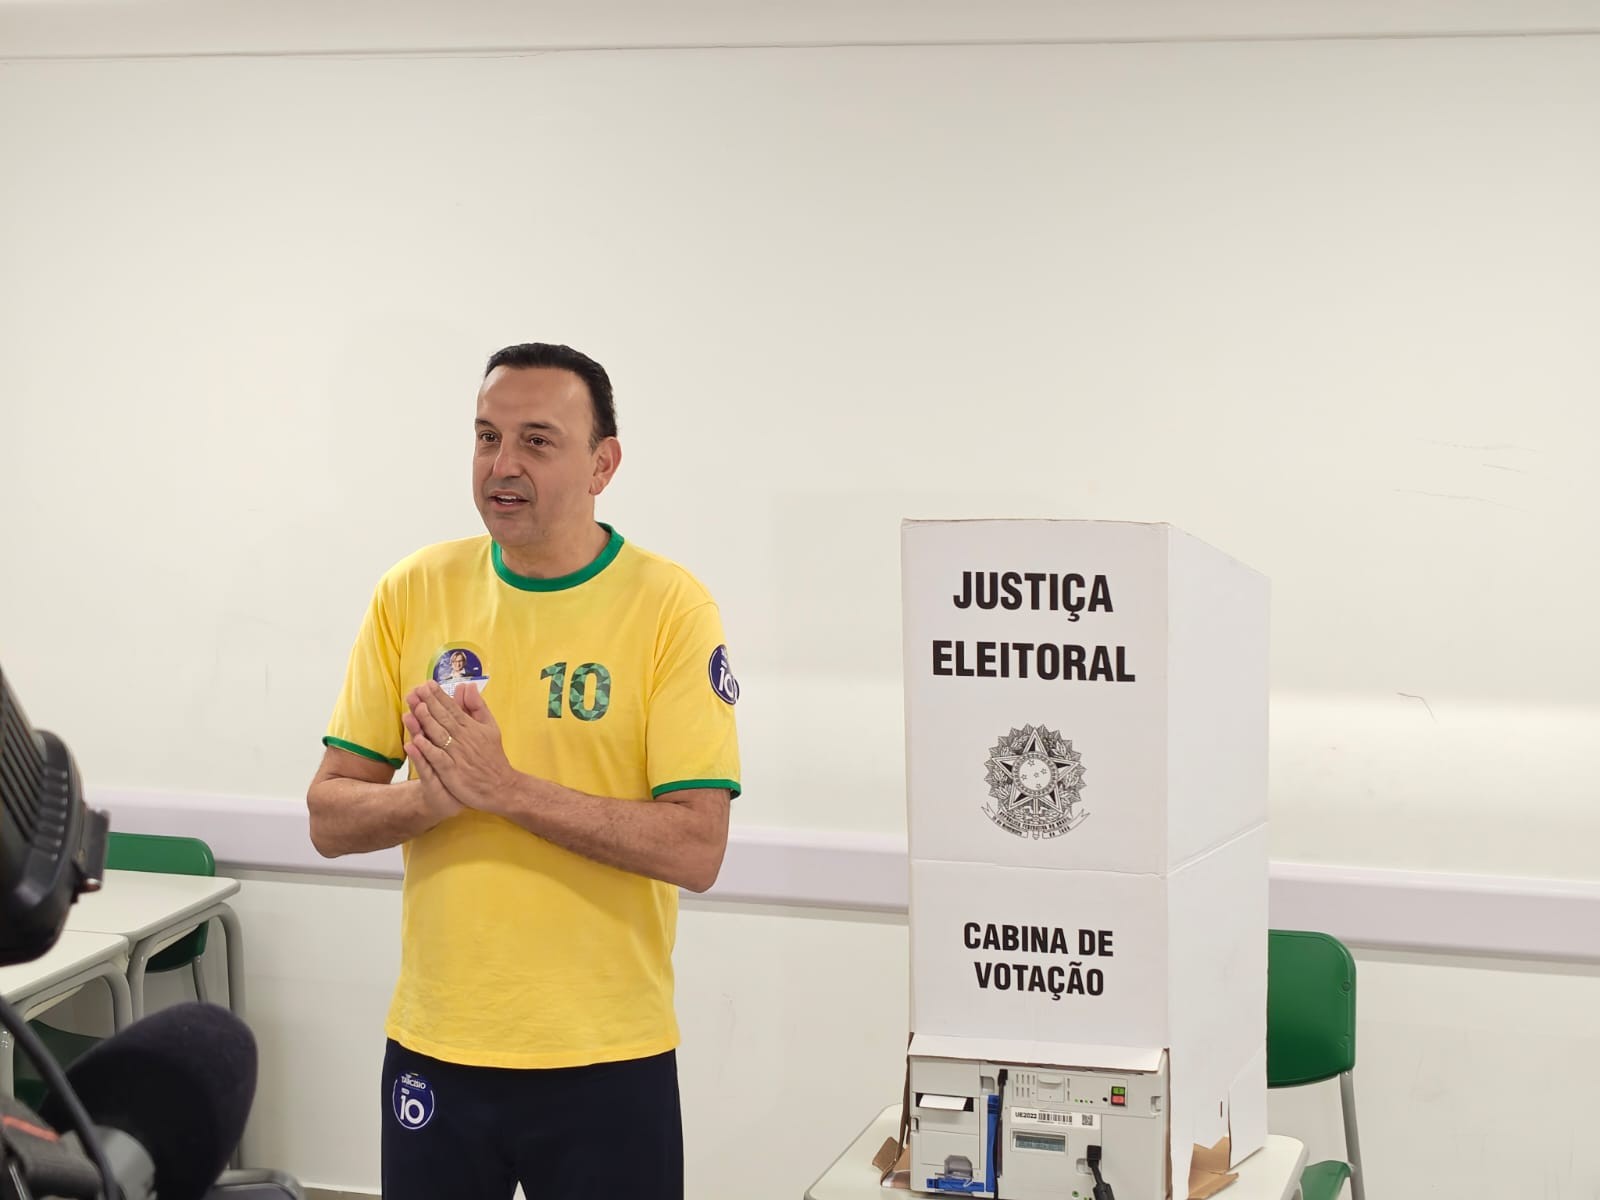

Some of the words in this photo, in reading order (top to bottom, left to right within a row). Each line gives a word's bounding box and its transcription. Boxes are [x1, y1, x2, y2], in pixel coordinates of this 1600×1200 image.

[953, 571, 1114, 622] JUSTIÇA
[933, 640, 1136, 682] ELEITORAL
[540, 661, 612, 721] 10
[963, 922, 1068, 954] CABINA
[1078, 929, 1114, 957] DE
[974, 961, 1104, 1001] VOTAÇÃO
